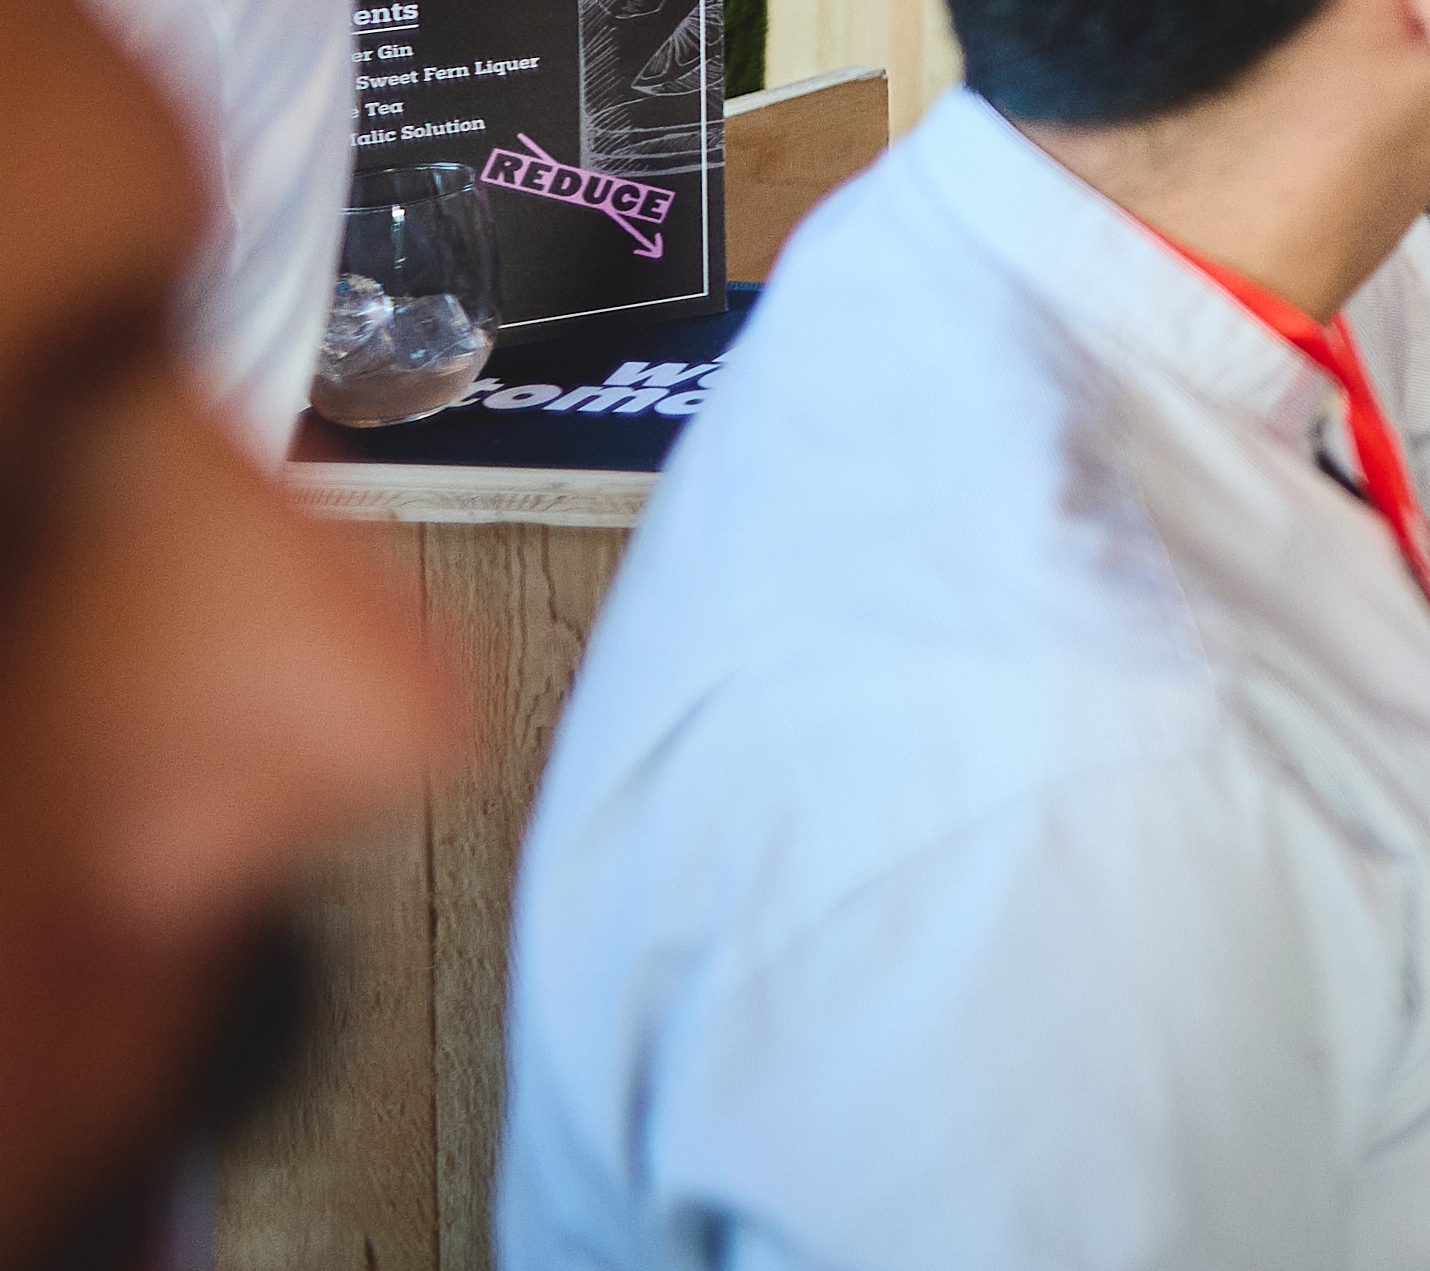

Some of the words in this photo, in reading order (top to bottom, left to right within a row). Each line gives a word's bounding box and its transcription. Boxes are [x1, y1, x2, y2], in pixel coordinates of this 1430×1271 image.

[377, 44, 415, 60] Gin
[355, 70, 419, 91] Sweet
[423, 65, 471, 82] Fern
[474, 56, 541, 76] Liquer
[364, 100, 406, 118] Tea
[400, 117, 487, 140] Solution
[487, 156, 674, 220] REDUCE
